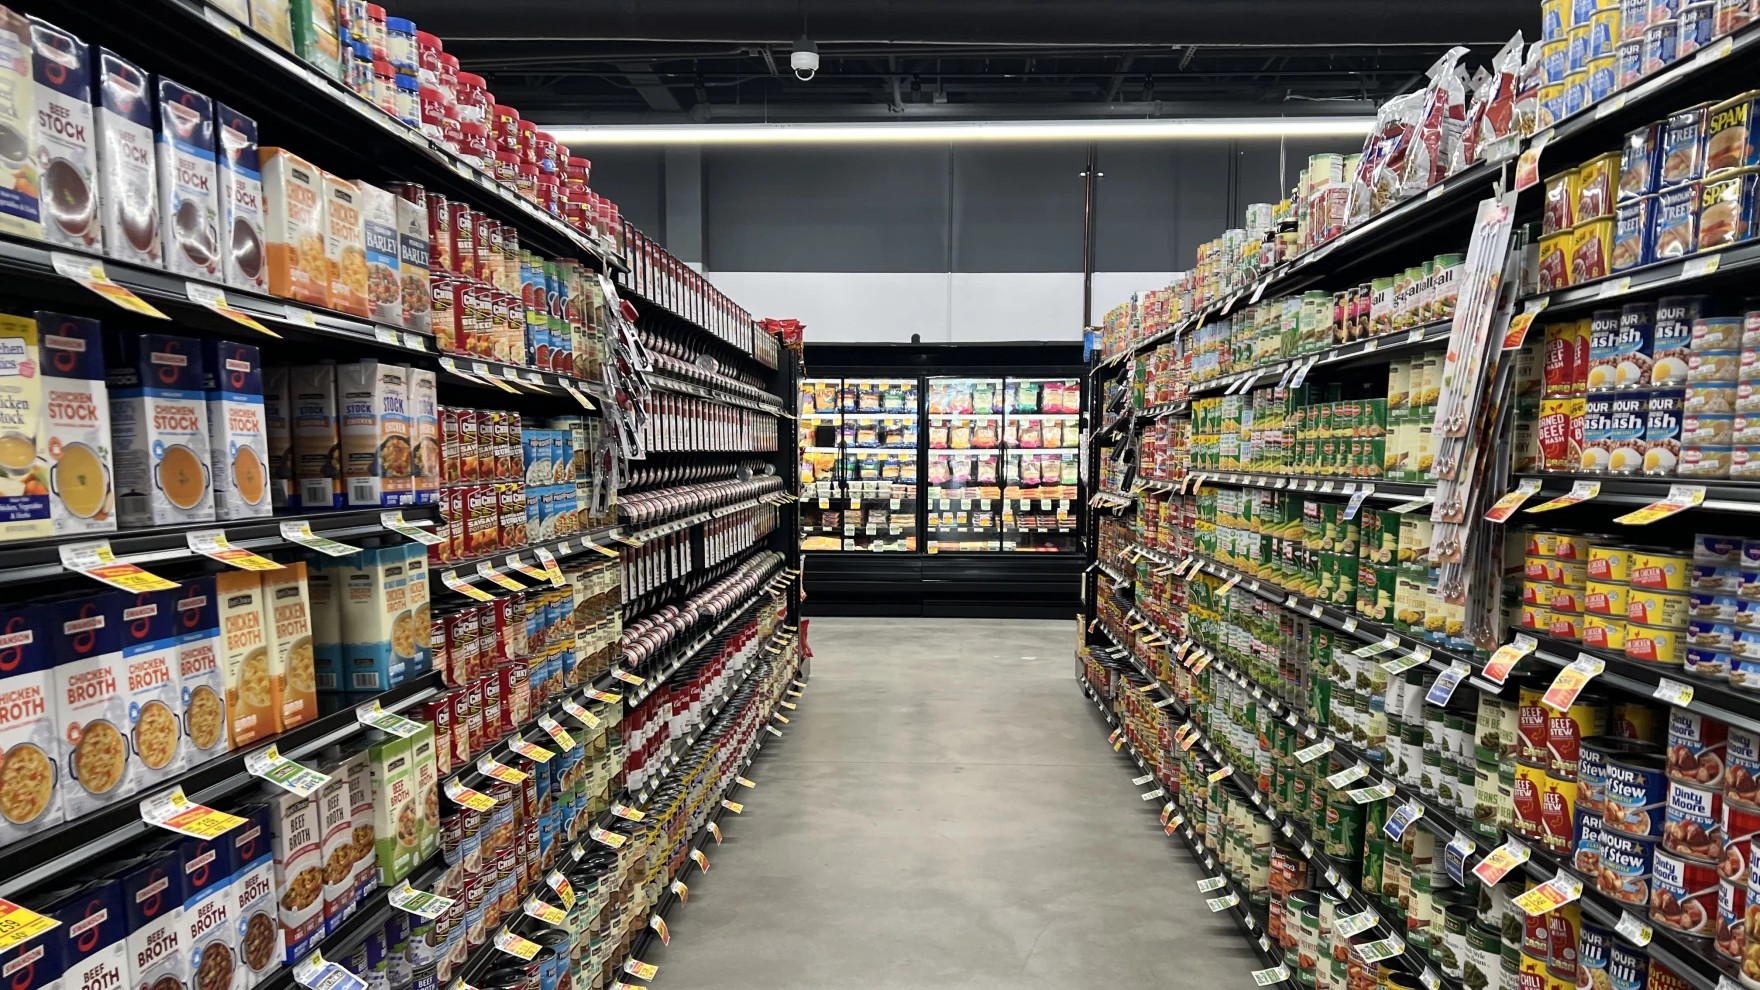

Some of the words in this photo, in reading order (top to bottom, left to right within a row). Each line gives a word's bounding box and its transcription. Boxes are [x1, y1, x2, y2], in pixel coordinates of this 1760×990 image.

[49, 102, 71, 119] BEEF
[1709, 103, 1749, 134] SPAM
[38, 110, 86, 143] STOCK
[366, 231, 397, 254] BARLEY
[401, 245, 429, 270] BARLEY
[49, 391, 92, 403] CHICKEN
[383, 397, 403, 413] STOCK
[48, 404, 97, 421] STOCK
[154, 405, 195, 416] CHICKEN
[229, 408, 256, 418] CHICKEN
[346, 404, 371, 413] STOCK
[154, 416, 199, 431] STOCK
[229, 418, 259, 432] STOCK
[1539, 425, 1565, 440] BEEF
[1545, 436, 1565, 445] HASH
[274, 602, 306, 624] CHICKEN
[225, 611, 260, 634] CHICKEN
[276, 619, 308, 639] BROTH
[226, 629, 262, 651] BROTH
[180, 645, 213, 661] CHICKEN
[129, 657, 166, 675] CHICKEN
[180, 656, 216, 677] BROTH
[68, 666, 112, 686] CHICKEN
[128, 669, 170, 691] BROTH
[67, 677, 116, 705] BROTH
[1521, 715, 1543, 725] STEW
[1522, 707, 1541, 719] BEEF
[1550, 726, 1573, 737] STEW
[1551, 718, 1571, 730] BEEF
[1678, 738, 1703, 748] STEW
[392, 779, 404, 795] BEEF
[1612, 780, 1646, 799] Stew
[1674, 786, 1703, 806] Dinty
[327, 792, 340, 811] BEEF
[391, 789, 410, 808] BROTH
[1672, 796, 1706, 815] Moore
[290, 814, 305, 832] BEEF
[326, 808, 345, 829] BROTH
[1688, 812, 1714, 825] STEW
[289, 830, 311, 852] BROTH
[1609, 848, 1643, 868] Stew
[1655, 854, 1676, 875] Dinty
[245, 874, 259, 890] BEEF
[1653, 864, 1679, 884] Moore
[239, 878, 270, 908] BROTH
[1663, 881, 1687, 895] STEW
[198, 902, 214, 918] BEEF
[191, 905, 227, 939] BROTH
[1549, 917, 1567, 932] CHILI
[147, 927, 165, 946] BEEF
[138, 932, 178, 968] BROTH
[84, 963, 104, 983] BEEF
[1520, 972, 1540, 987] CHILI
[418, 977, 433, 989] BEEF
